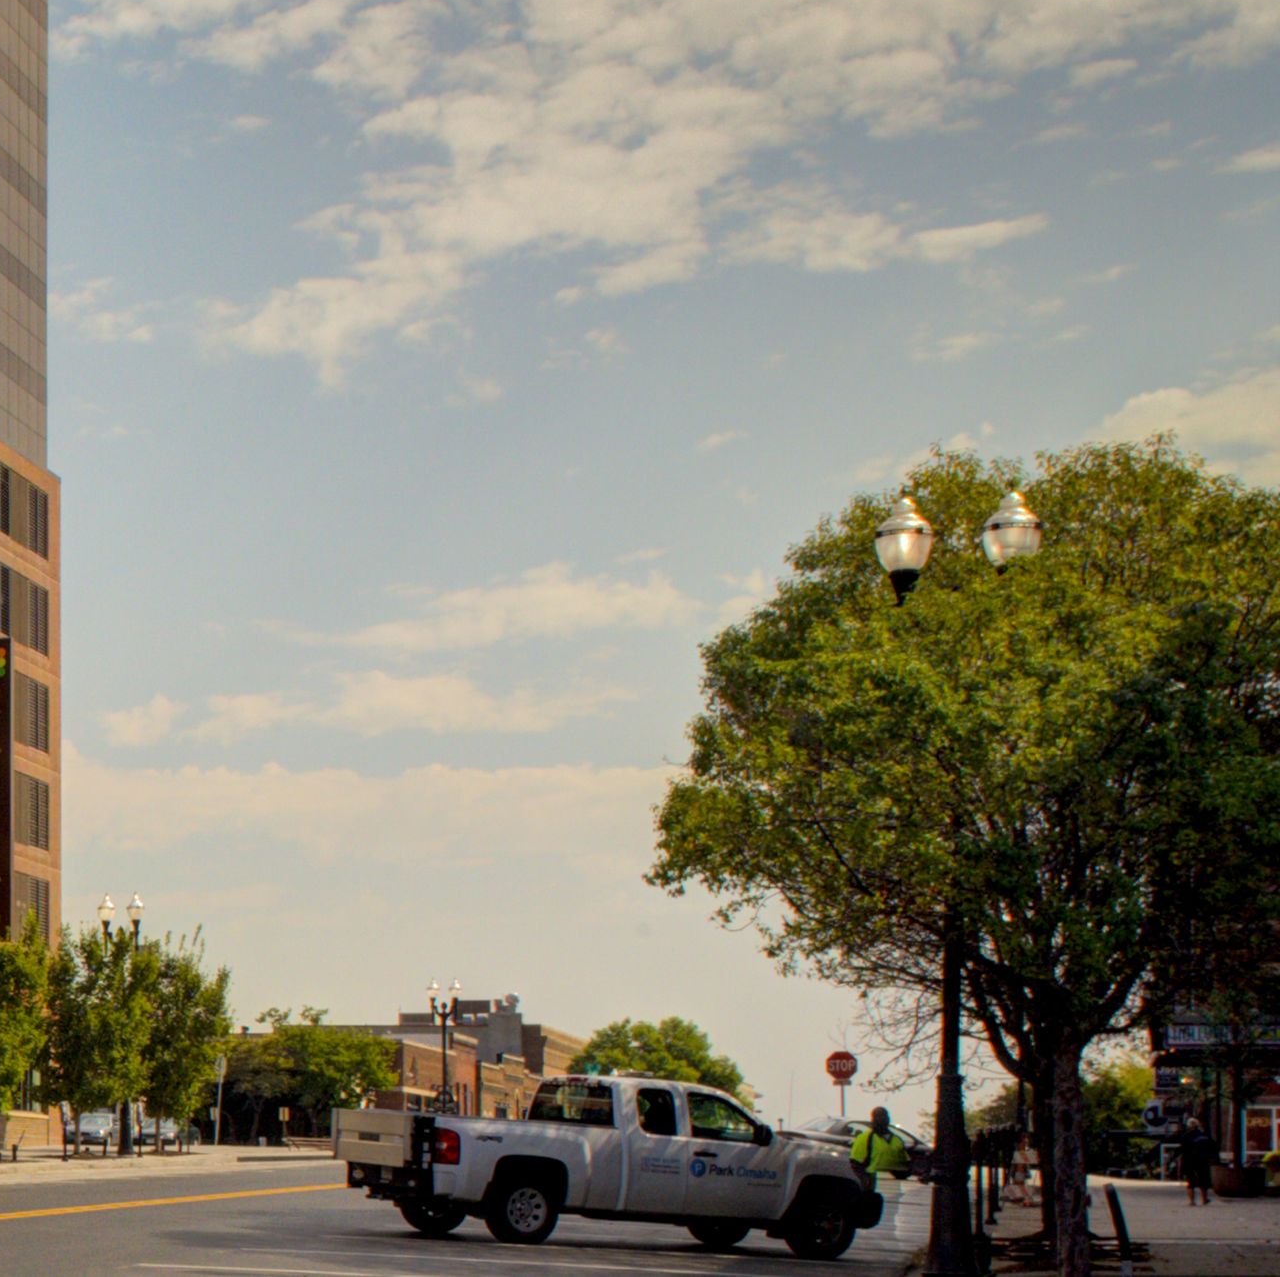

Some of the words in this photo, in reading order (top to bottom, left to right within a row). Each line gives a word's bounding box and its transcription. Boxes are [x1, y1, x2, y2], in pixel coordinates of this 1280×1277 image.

[829, 1059, 855, 1072] STOP
[709, 1164, 734, 1177] Park
[737, 1167, 777, 1180] Omaha
